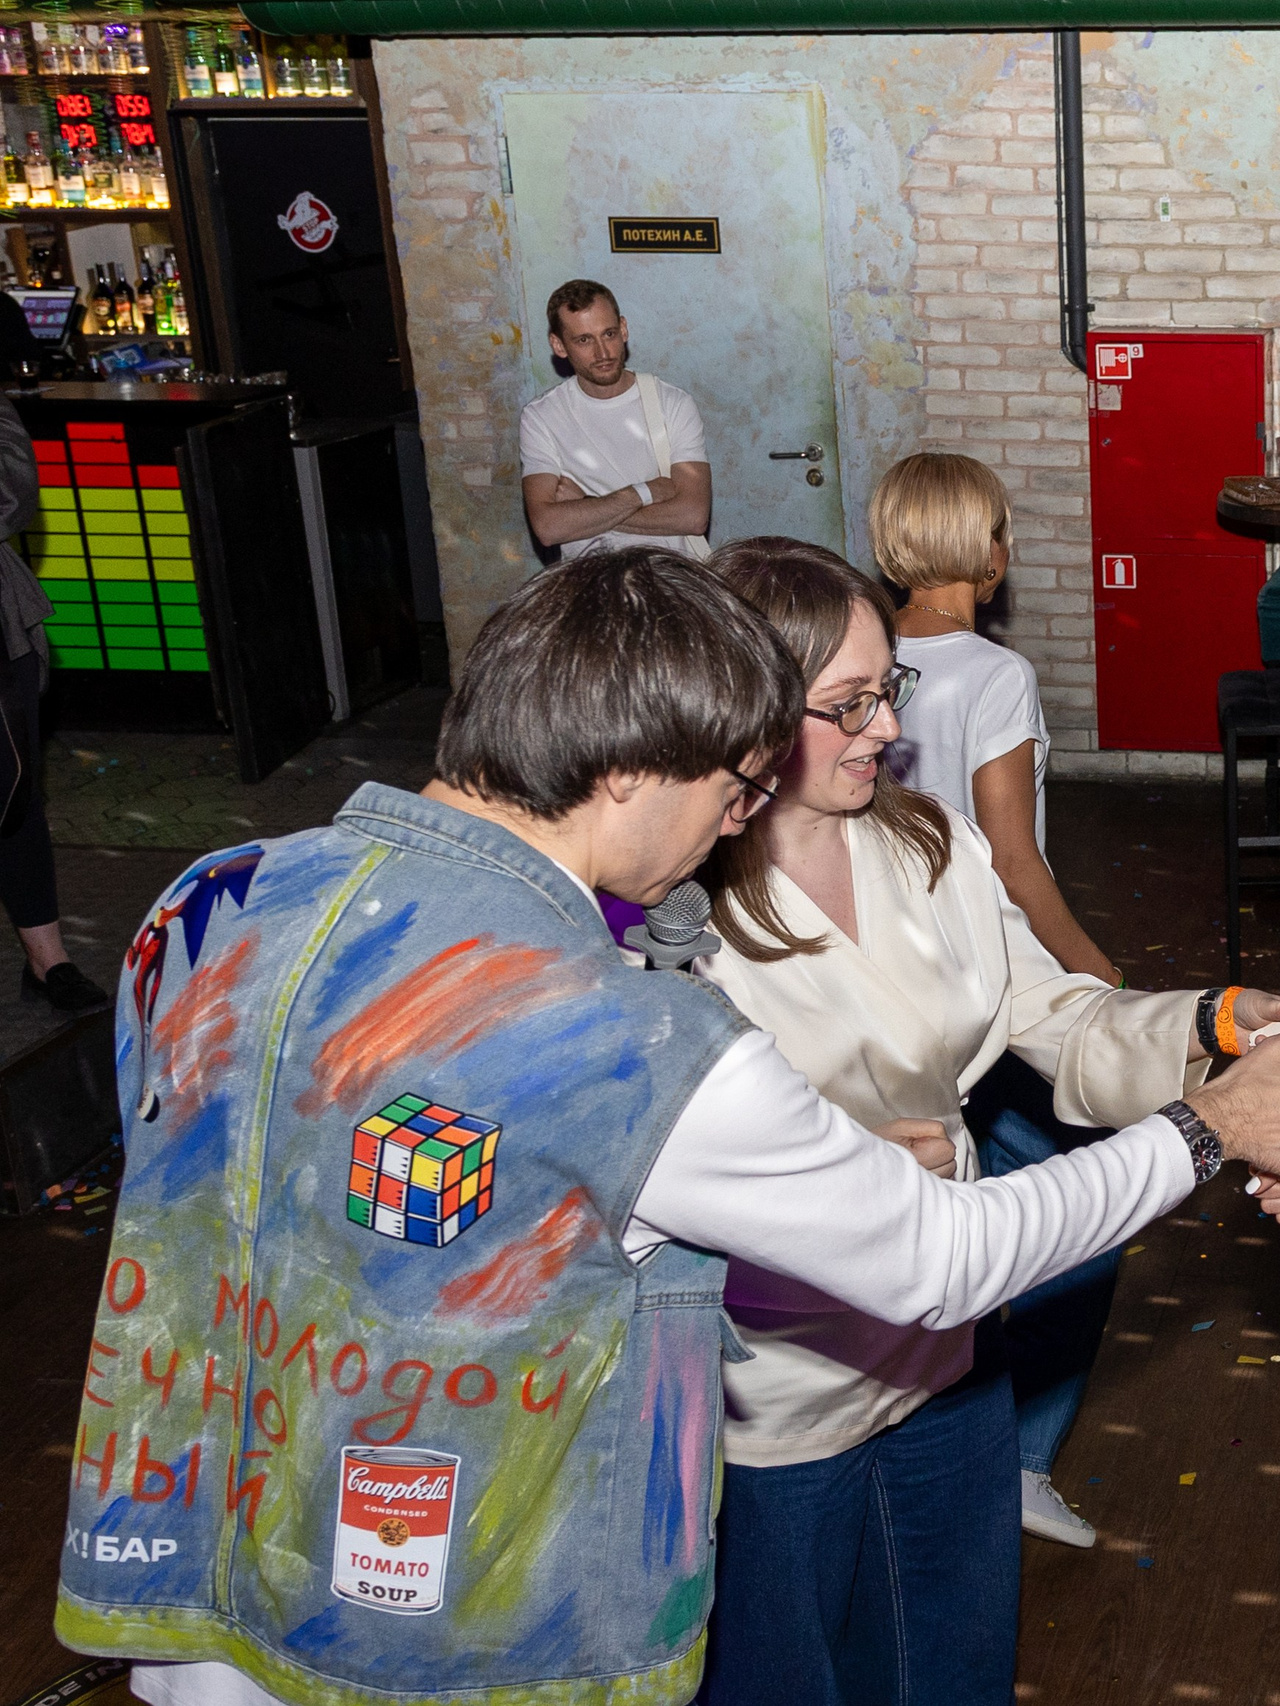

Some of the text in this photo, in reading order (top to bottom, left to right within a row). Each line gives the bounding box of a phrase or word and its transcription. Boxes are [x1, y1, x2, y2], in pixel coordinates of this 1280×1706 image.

[622, 229, 707, 241] ПОТЕХИН А.Е.
[1132, 346, 1140, 356] 9
[363, 1504, 428, 1517] CONDENSED
[350, 1552, 430, 1578] TOMATO
[358, 1581, 417, 1602] SOUP
